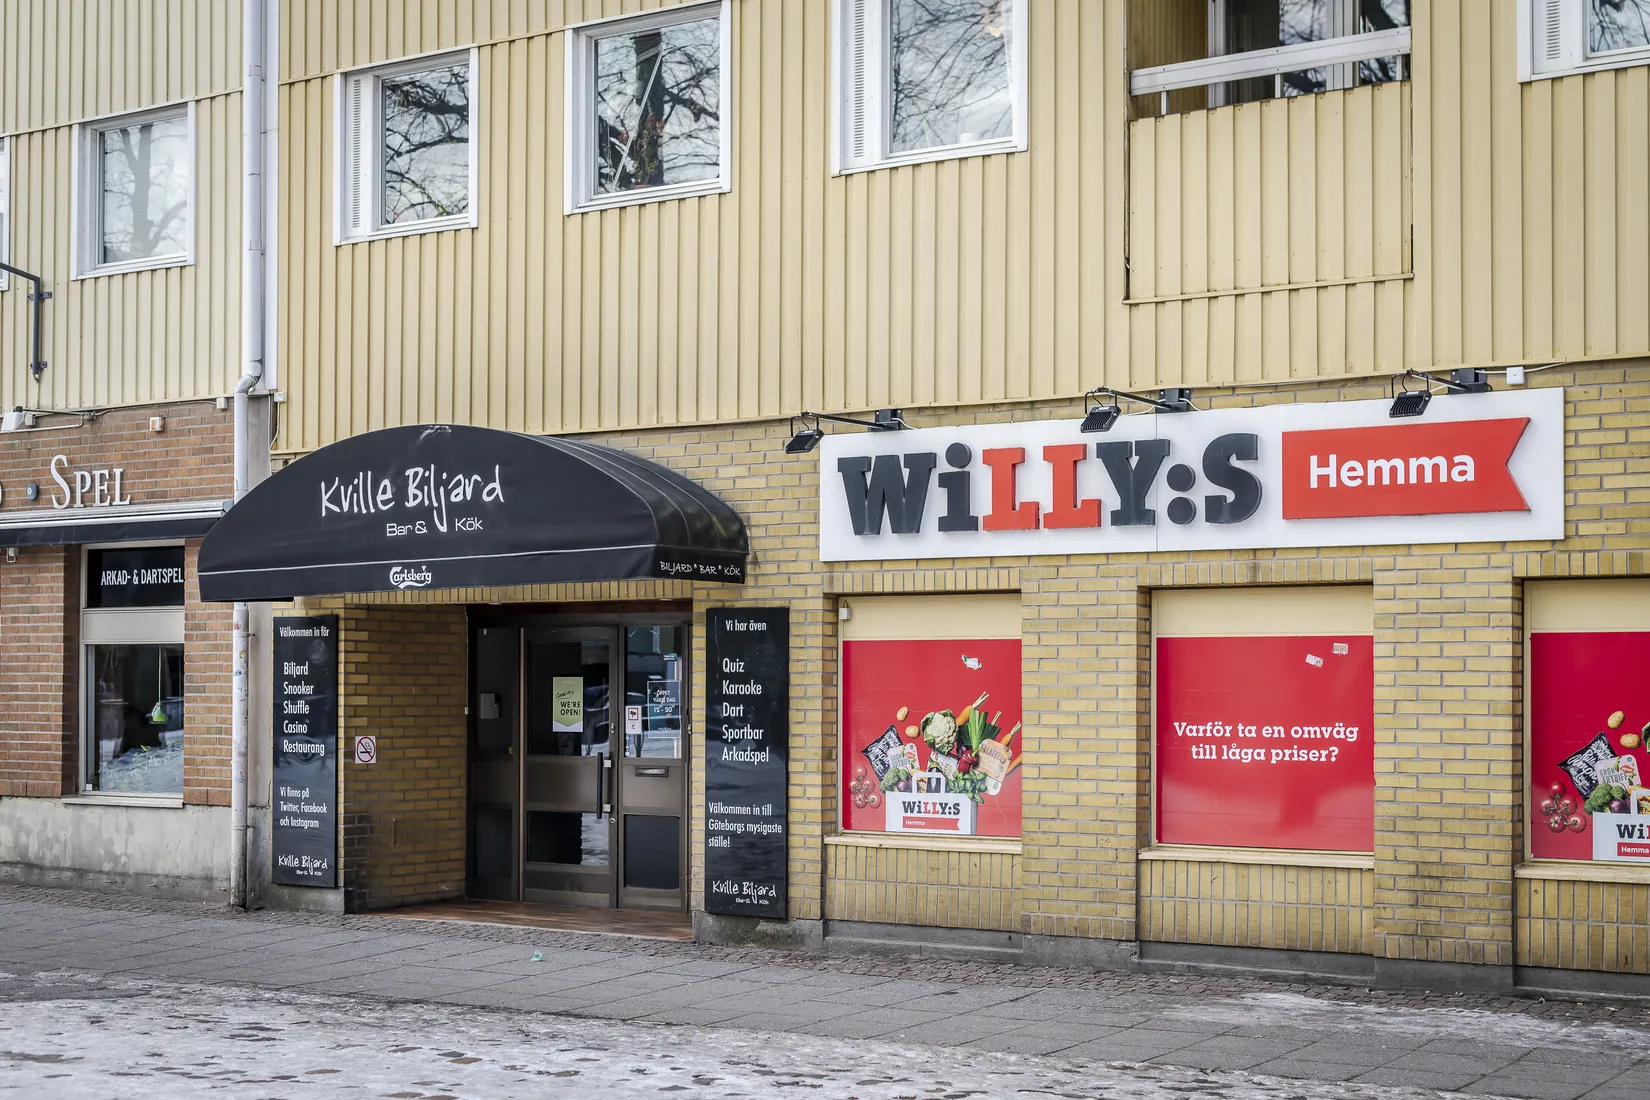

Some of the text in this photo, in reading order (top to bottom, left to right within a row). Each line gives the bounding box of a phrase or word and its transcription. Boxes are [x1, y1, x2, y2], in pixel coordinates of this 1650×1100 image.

[1309, 449, 1476, 488] Hemma
[319, 464, 505, 533] Kville Biljard
[386, 516, 483, 537] Bar & Kök
[660, 561, 741, 576] BILJARD BAR KÖK
[100, 567, 184, 586] ARKAD- & DARTSPEL
[389, 565, 432, 588] Carlsberg
[279, 626, 330, 638] Välkommen in för
[725, 620, 767, 632] Vi har även
[283, 661, 309, 678] Biljard
[722, 657, 745, 674] Quiz
[283, 682, 314, 695] Snooker
[722, 680, 762, 695] Karaoke
[283, 700, 310, 715] Shuffle
[560, 708, 581, 716] OPEN!
[722, 702, 744, 717] Dart
[283, 719, 308, 734] Casino
[722, 724, 764, 743] Sportbar
[1173, 721, 1359, 742] Varför ta en omväg
[283, 740, 325, 756] Restaurang
[721, 746, 769, 765] Arkadspel
[1191, 743, 1339, 764] till låga priser?
[279, 786, 310, 800] Vi finns på
[280, 801, 327, 814] Twitter, Facebook
[708, 802, 772, 816] Välkommen in till
[902, 800, 961, 816] WiLLY:S
[280, 816, 319, 829] och Instagram
[708, 818, 783, 835] Göteborgs mysigaste
[905, 819, 926, 827] Hemma
[708, 835, 730, 848] ställe!
[1621, 846, 1650, 854] Hemma
[278, 855, 328, 876] Kville Biljard
[712, 880, 777, 904] Kville Biljard
